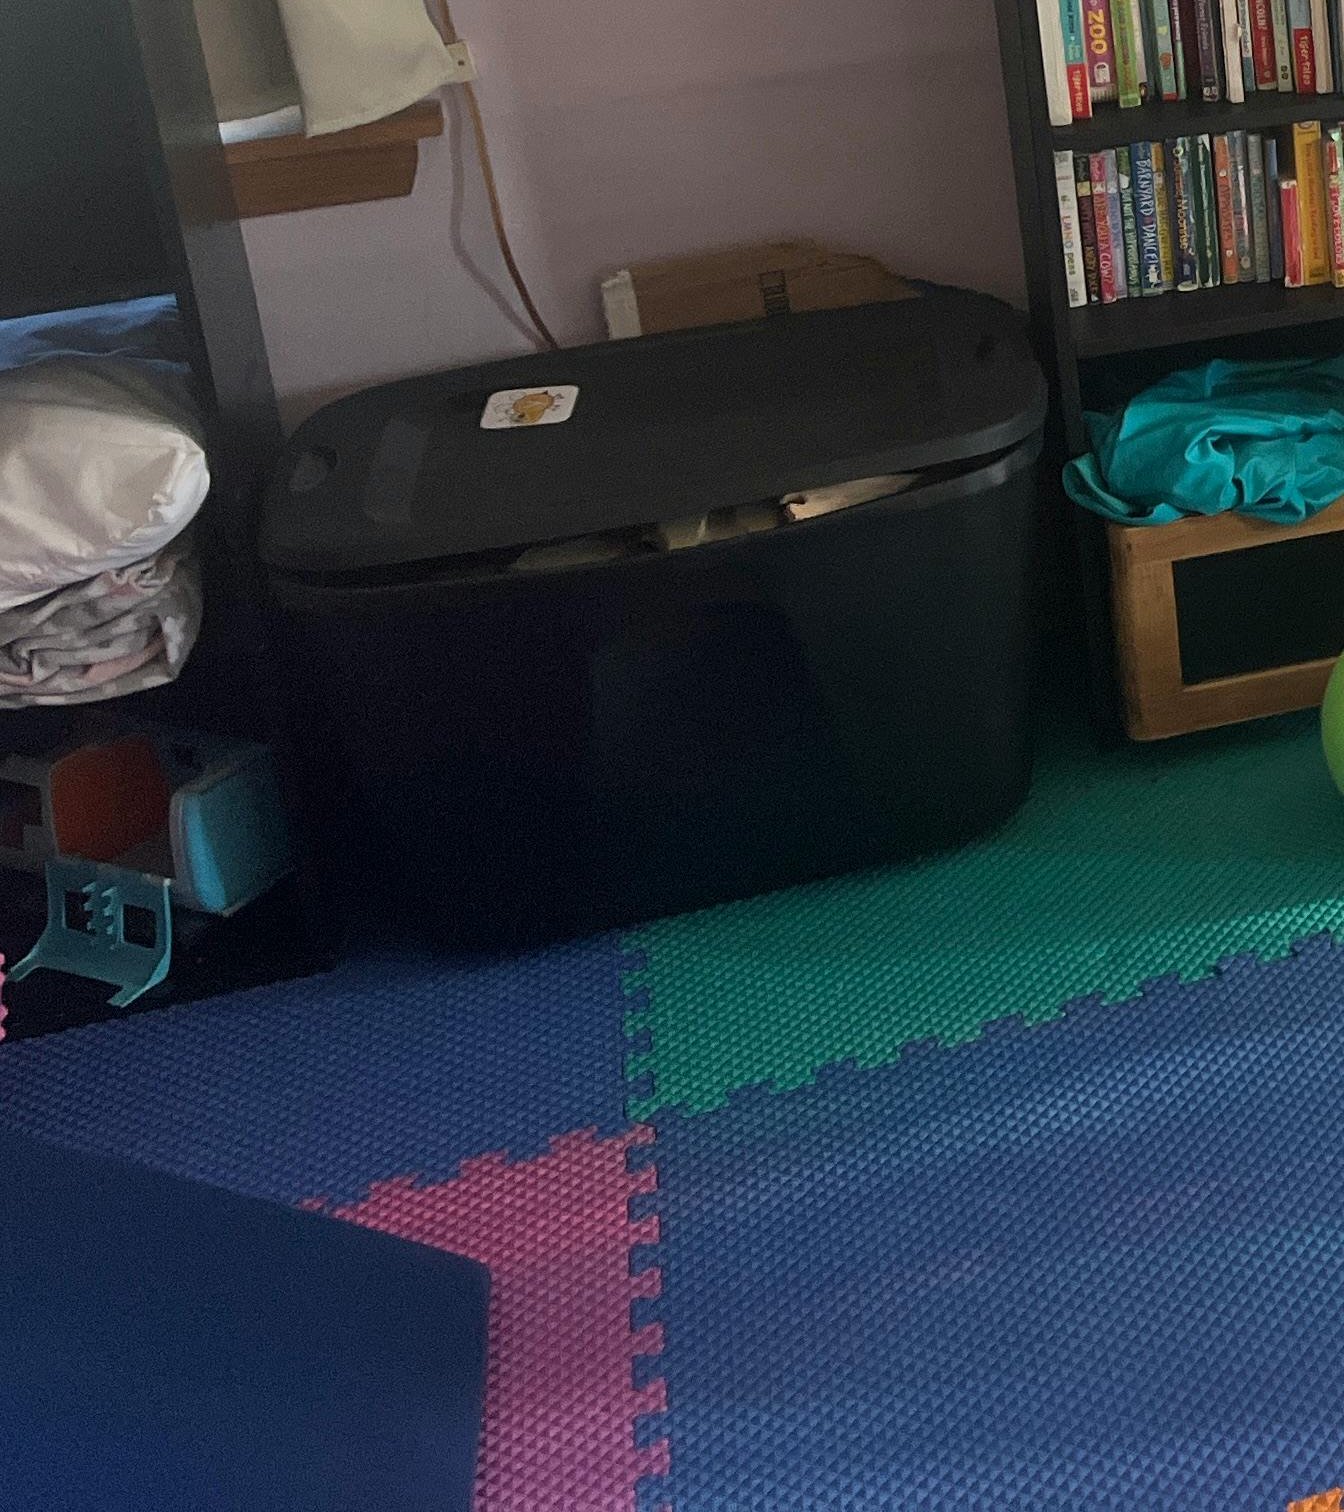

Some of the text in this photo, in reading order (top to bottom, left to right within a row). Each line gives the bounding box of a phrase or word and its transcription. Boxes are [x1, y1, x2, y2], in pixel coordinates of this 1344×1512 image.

[1087, 8, 1107, 56] ZOO
[1297, 35, 1310, 59] tiger
[1135, 158, 1158, 263] BARNYARD DANCE!
[1099, 252, 1113, 283] COW?
